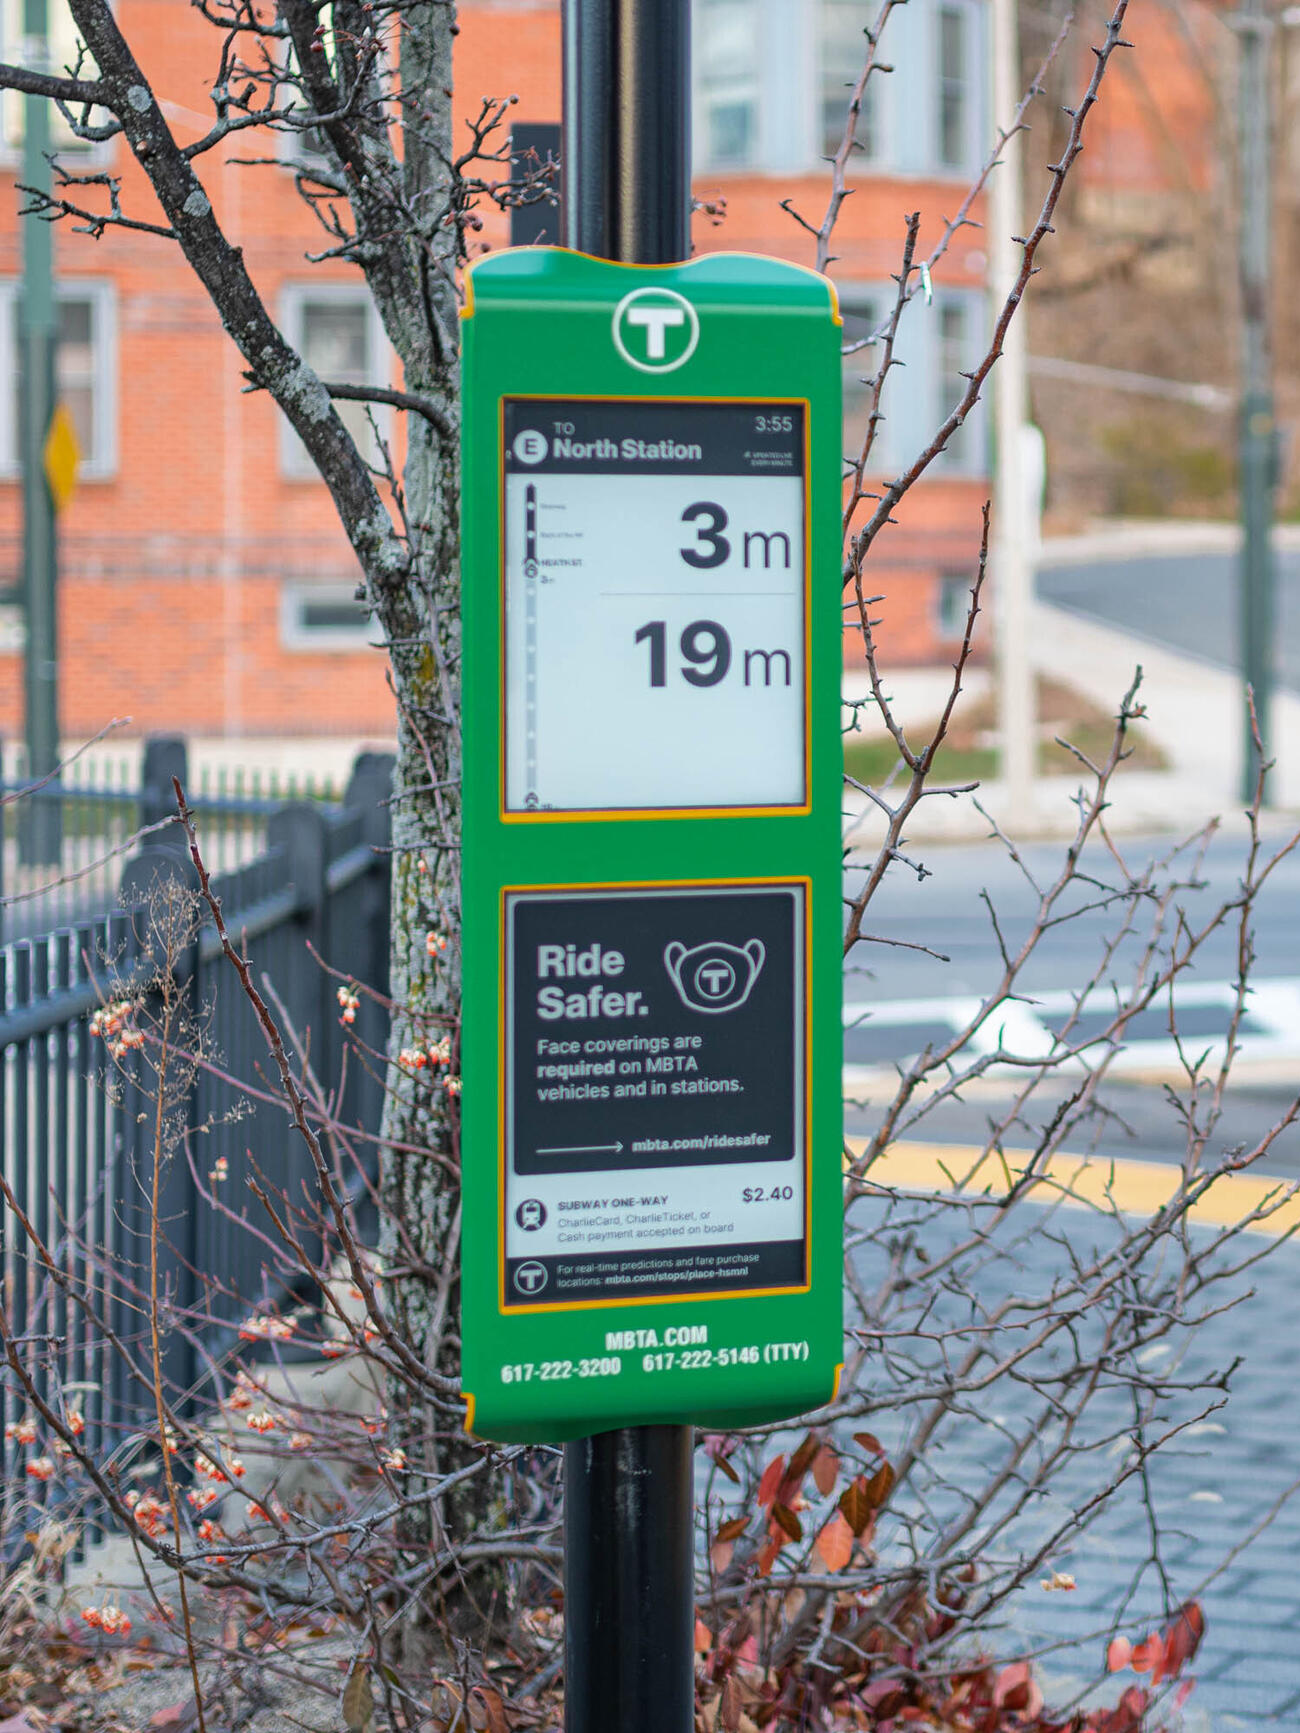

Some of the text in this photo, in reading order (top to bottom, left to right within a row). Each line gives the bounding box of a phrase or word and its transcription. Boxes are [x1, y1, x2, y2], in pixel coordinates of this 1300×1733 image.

[553, 422, 576, 435] TO
[755, 416, 792, 432] 3:55
[525, 438, 538, 455] E
[553, 438, 618, 458] North
[622, 440, 702, 460] Station
[680, 501, 790, 569] 3 m
[635, 620, 791, 688] 19 m
[537, 943, 625, 978] Ride
[537, 985, 649, 1020] Safer.
[537, 1035, 702, 1055] Face coverings are
[537, 1056, 698, 1080] required on MBTA
[537, 1077, 745, 1101] vehicles and in stations.
[632, 1133, 771, 1153] mbta.com/ridesafer
[558, 1195, 669, 1211] SUBWAY ONE-WAY
[742, 1186, 793, 1203] $2.40
[558, 1210, 711, 1228] CharlieCard, CharlieTicket, or
[558, 1223, 734, 1242] Cash payment accepted on board
[557, 1253, 760, 1274] For real-time predictions and fare purchase
[605, 1325, 708, 1350] MBTA.COM
[501, 1341, 809, 1384] 617-222-3200 617-222-5146 (TTY)
